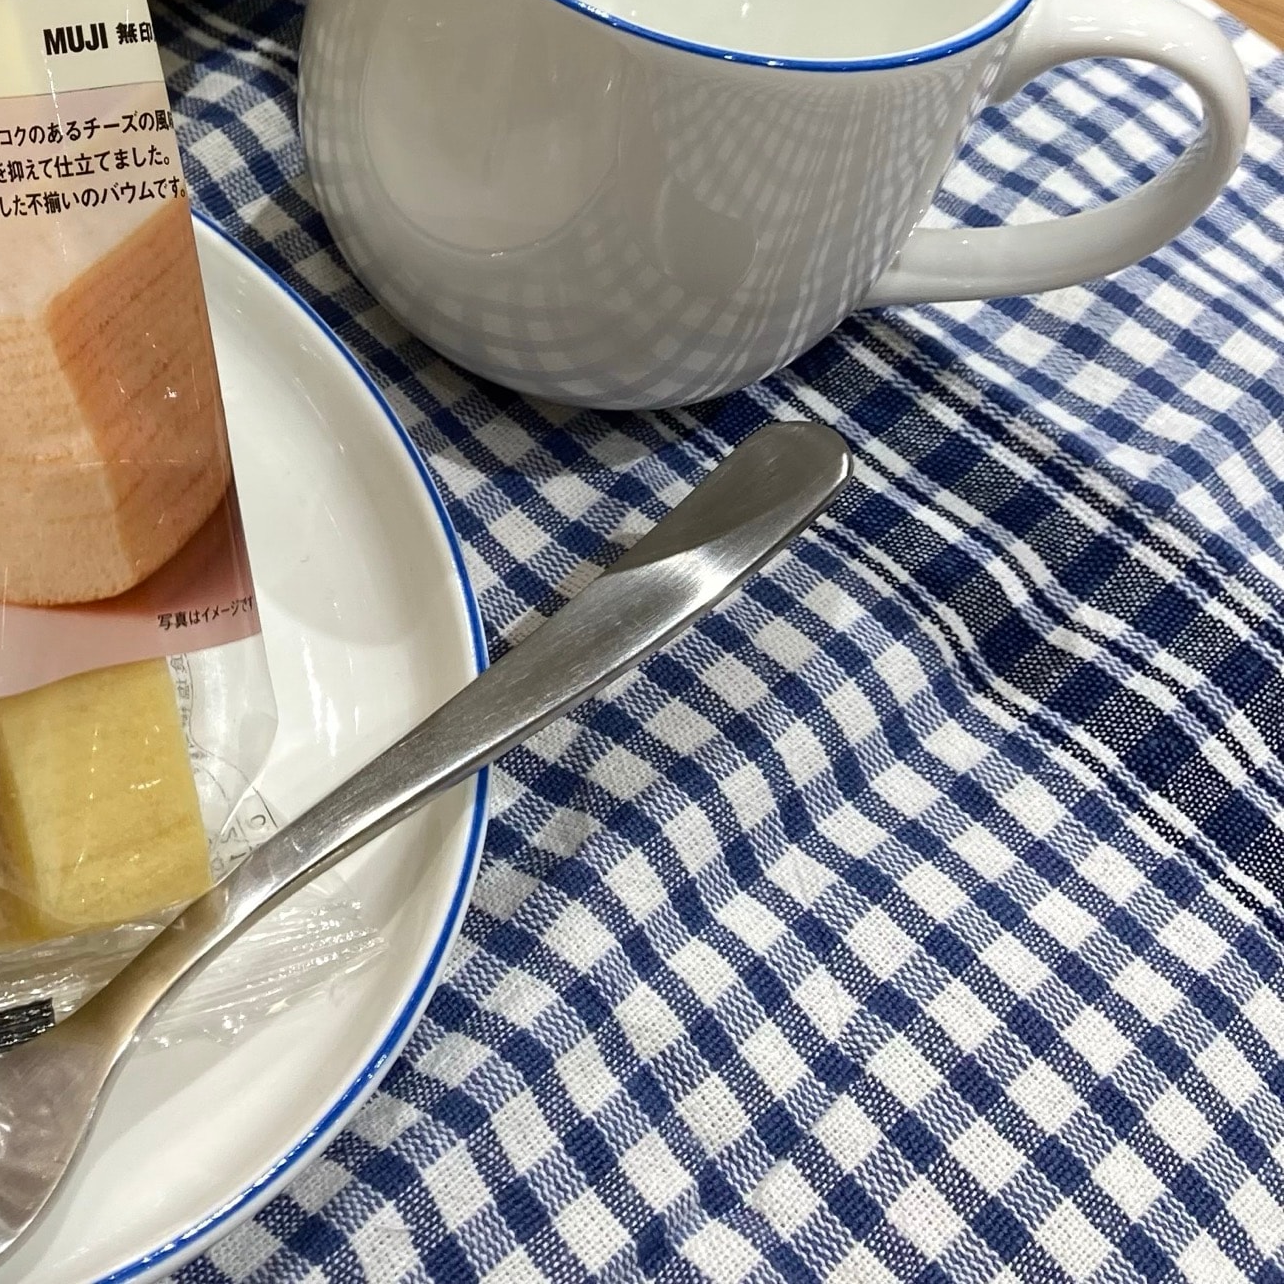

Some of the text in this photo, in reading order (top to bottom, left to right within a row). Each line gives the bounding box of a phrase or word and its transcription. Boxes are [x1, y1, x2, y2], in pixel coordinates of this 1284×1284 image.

[43, 21, 110, 57] MUJI
[157, 594, 254, 631] 写真はイメージです
